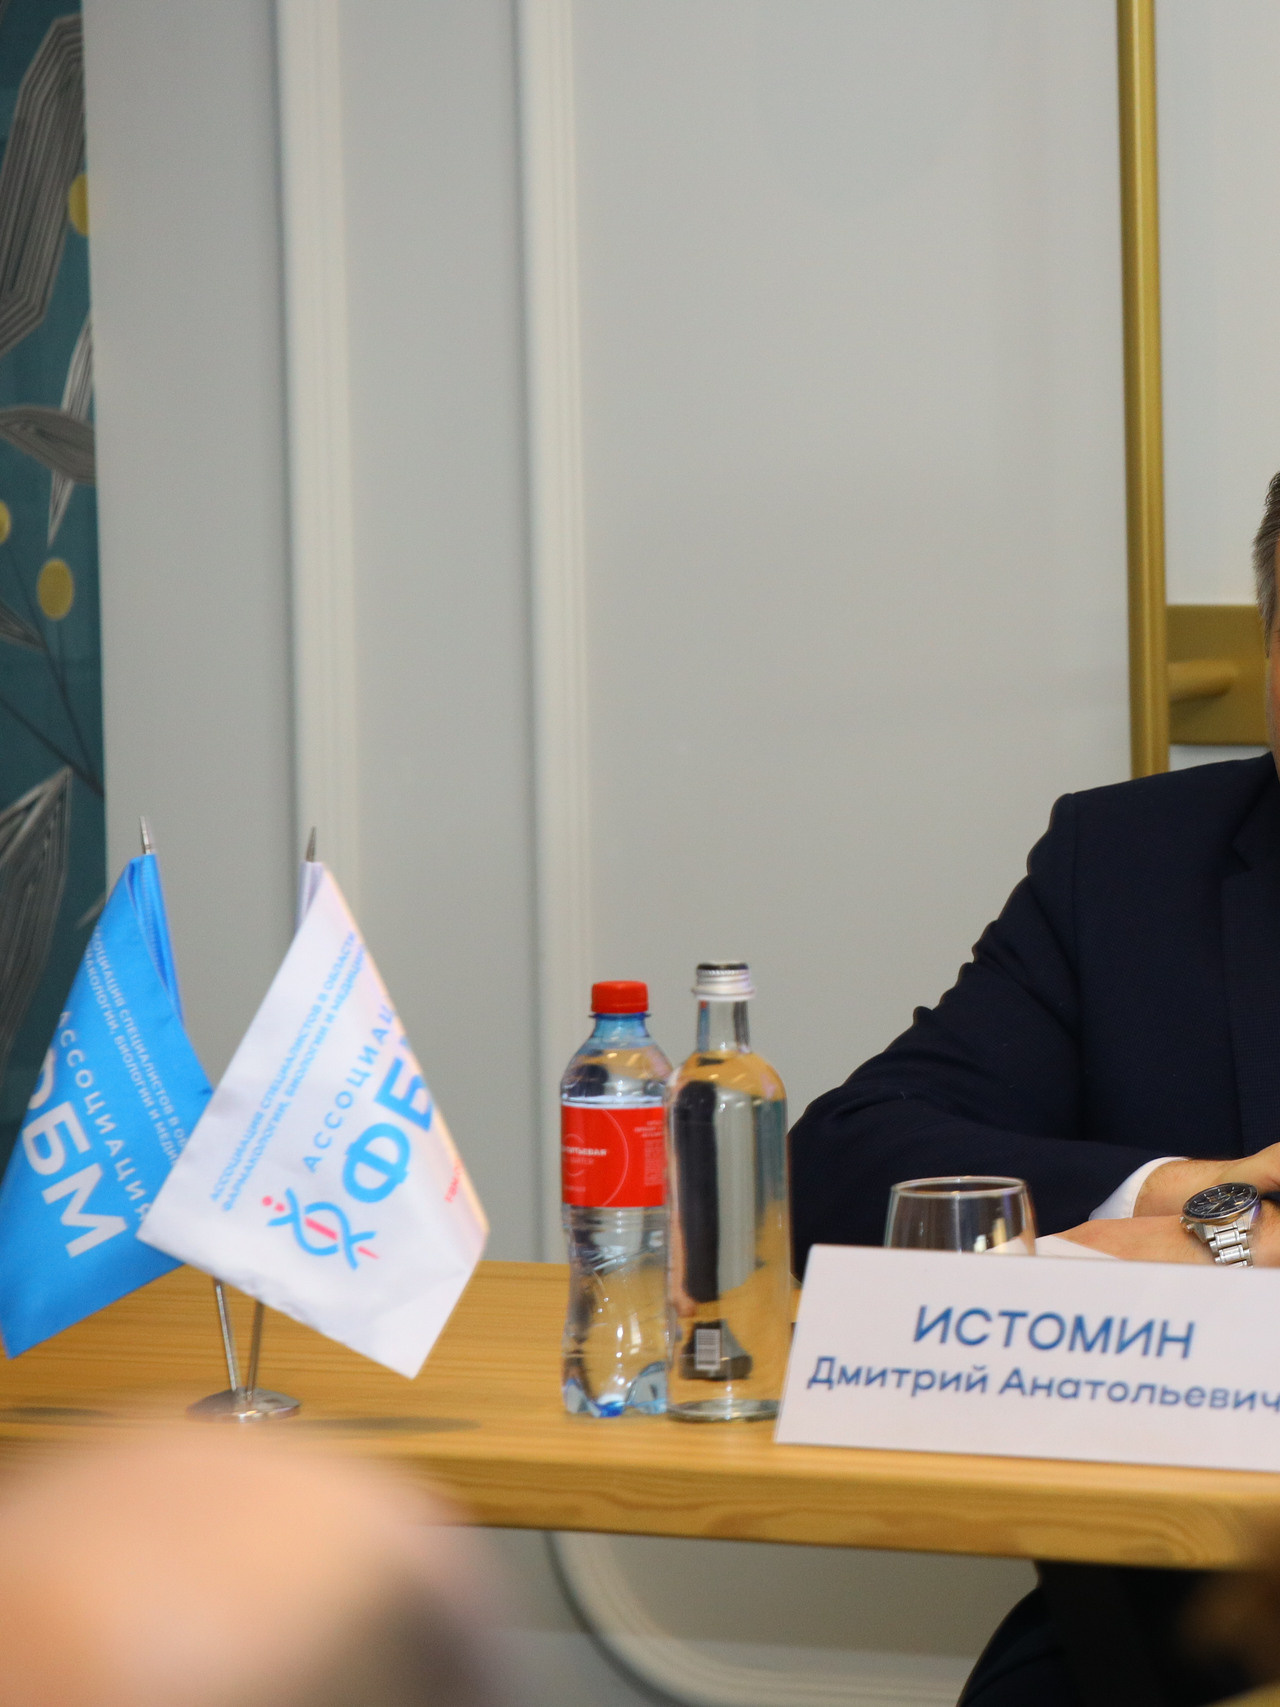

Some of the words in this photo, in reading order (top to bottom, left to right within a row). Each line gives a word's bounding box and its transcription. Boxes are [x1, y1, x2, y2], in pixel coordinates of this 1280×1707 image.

[114, 1035, 155, 1108] БИОЛОГИИ
[148, 1106, 161, 1120] И
[120, 1008, 175, 1115] СПЕЦИАЛИСТОВ
[168, 1116, 180, 1127] В
[303, 995, 397, 1174] АССОЦИАЦ
[342, 1036, 435, 1205] ФБ
[808, 1356, 988, 1397] Дмитрий
[914, 1305, 1196, 1360] ИСТОМИН
